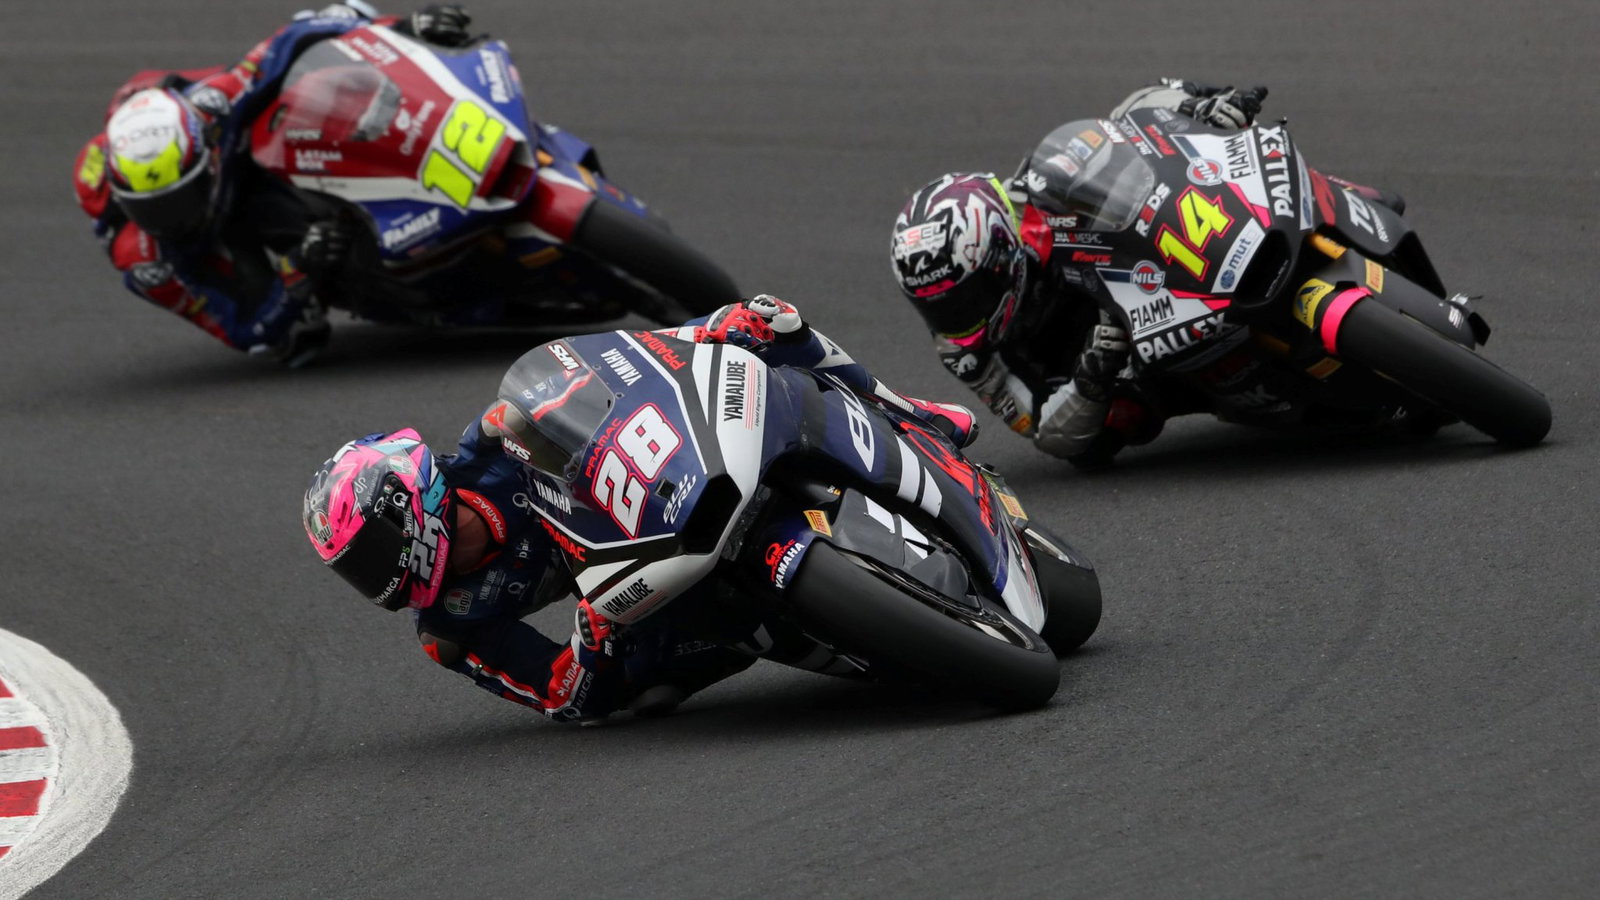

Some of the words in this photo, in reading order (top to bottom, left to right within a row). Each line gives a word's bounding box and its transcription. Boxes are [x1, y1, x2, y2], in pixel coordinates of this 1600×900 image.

[422, 100, 507, 209] 12
[1193, 157, 1222, 186] NILS
[1224, 134, 1253, 180] FIAMM
[1257, 126, 1295, 218] PALLEX
[382, 208, 440, 249] FAMILY
[1155, 186, 1234, 280] 14
[905, 264, 953, 287] SHARK
[1132, 271, 1164, 285] NILS
[1130, 295, 1174, 331] FIAMM
[547, 343, 580, 370] WRS
[633, 331, 687, 370] PRAMAC
[1136, 312, 1226, 364] PALLEX
[601, 347, 643, 387] YAMAHA
[724, 360, 747, 422] YAMALUBE
[503, 438, 531, 461] WRS
[585, 417, 622, 479] PRAMAC
[592, 403, 683, 540] 28
[472, 496, 505, 539] PRAMAC
[533, 479, 572, 515] YAMAHA
[775, 542, 805, 589] YAMAHA
[602, 578, 655, 616] YAMALUBE
